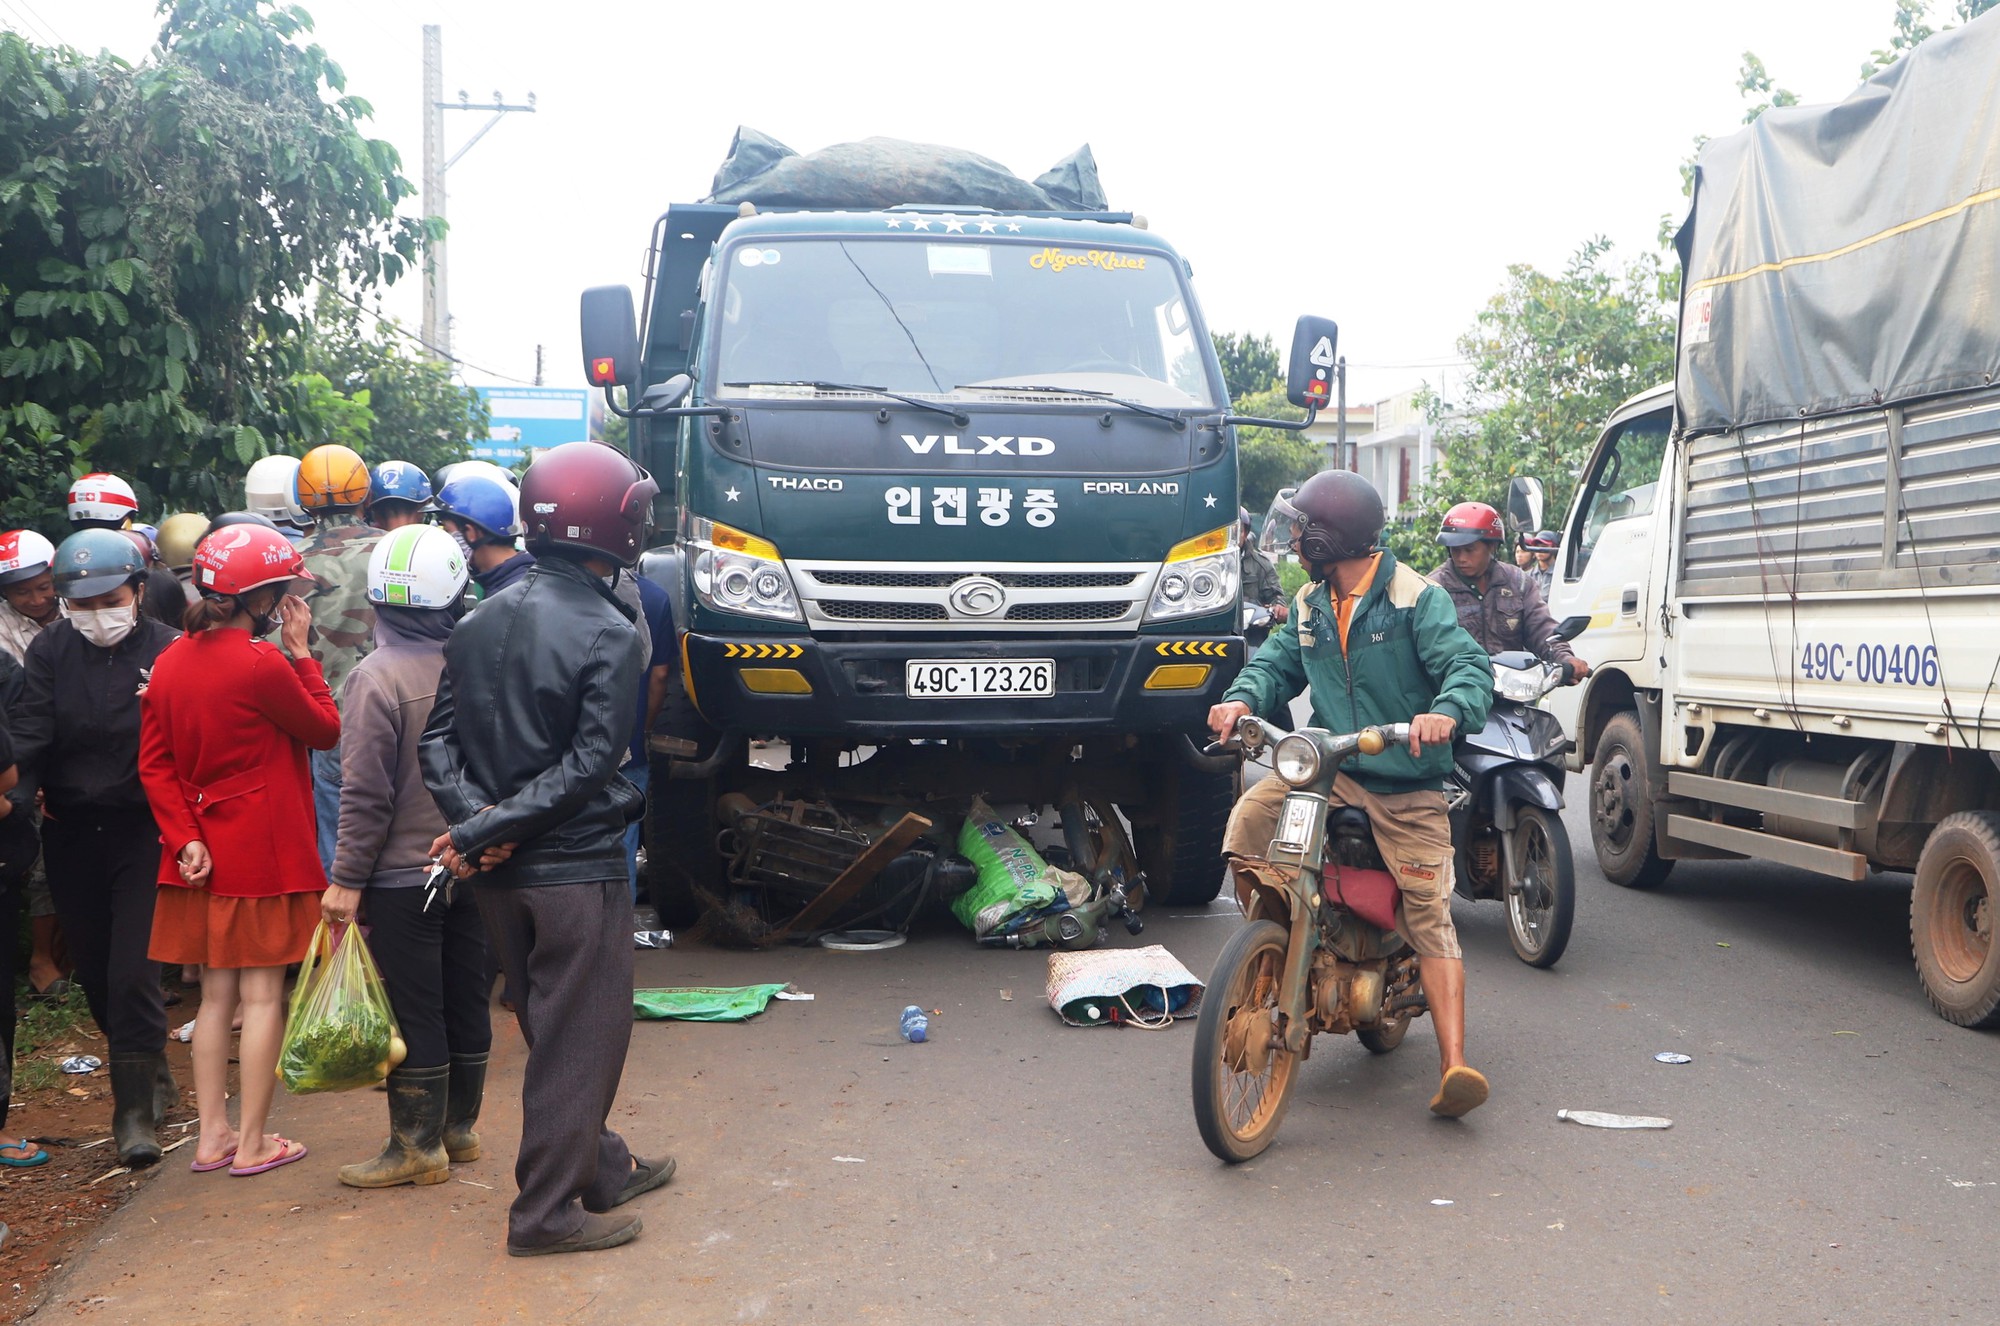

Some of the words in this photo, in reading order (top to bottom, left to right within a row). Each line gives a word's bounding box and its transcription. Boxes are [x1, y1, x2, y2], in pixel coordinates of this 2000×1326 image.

[900, 434, 1056, 456] VLXD
[768, 476, 844, 492] THACO
[1083, 481, 1179, 495] FORLAND
[1801, 642, 1938, 687] 49C-00406
[914, 666, 1048, 693] 49C-123.26
